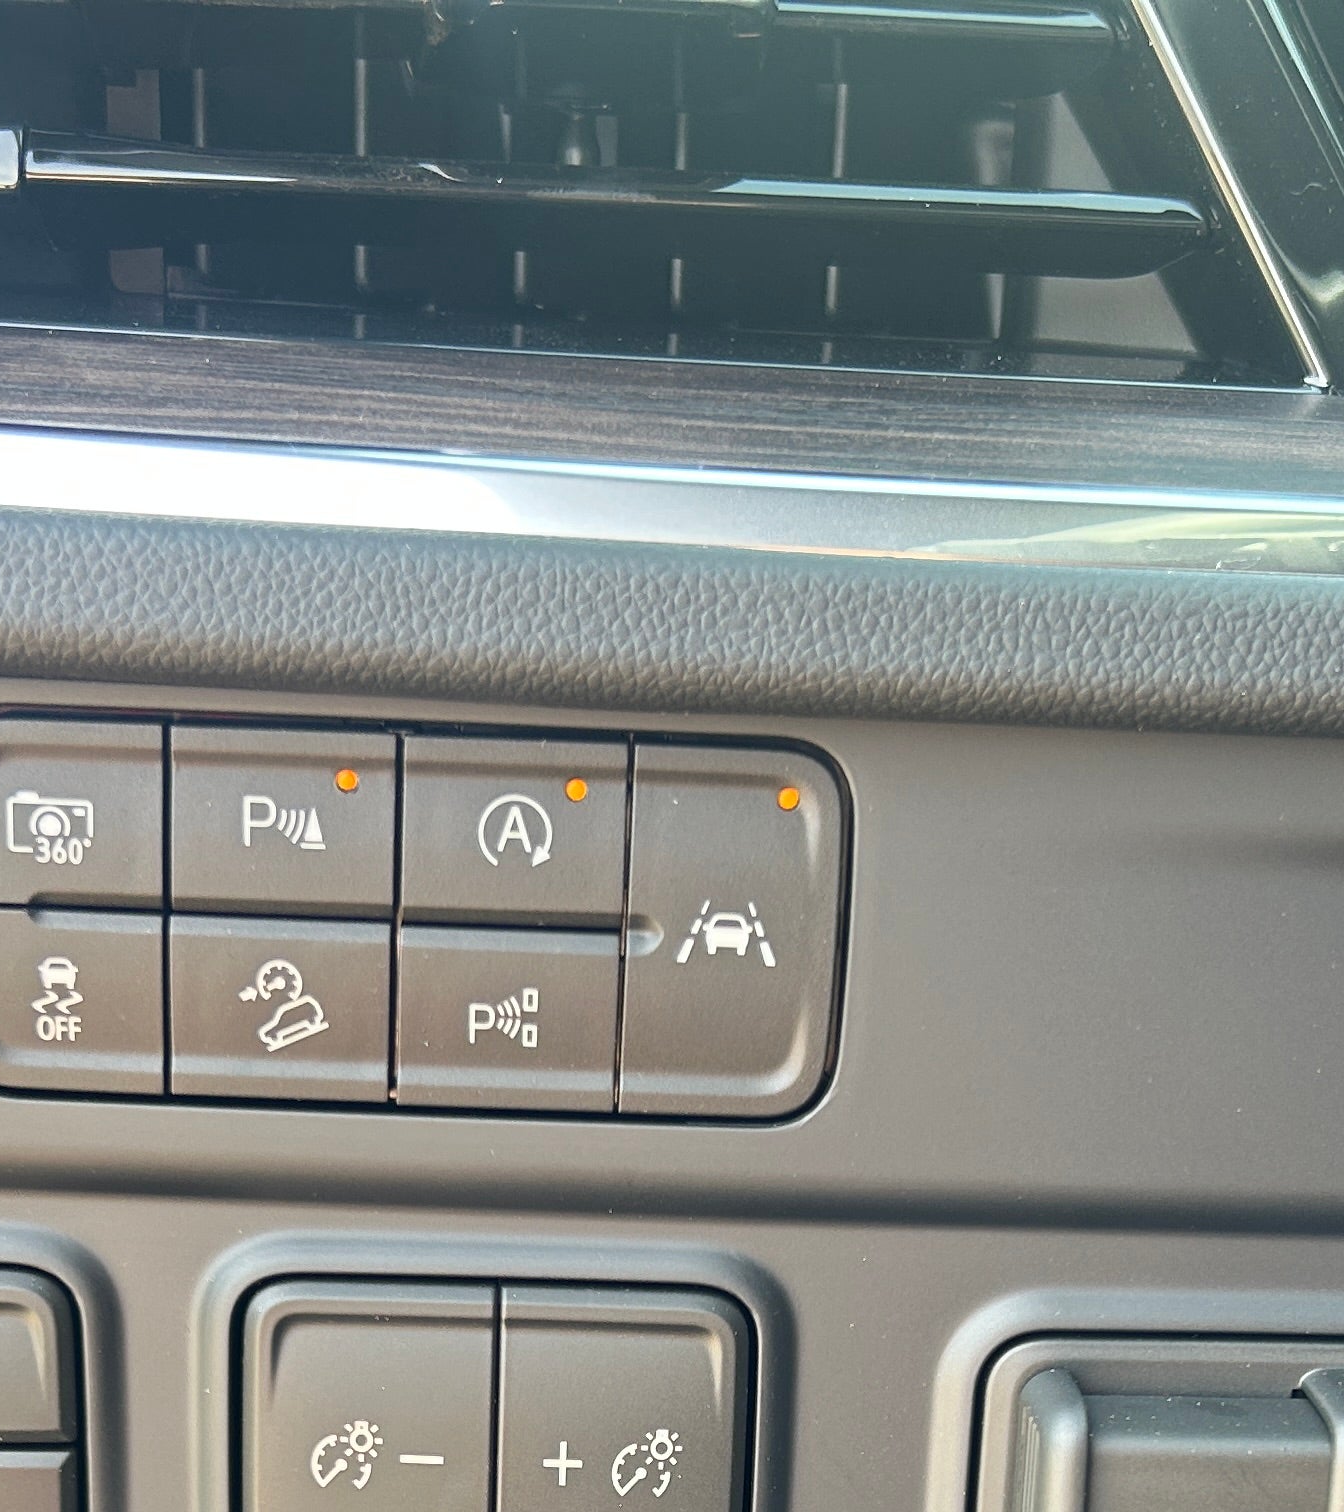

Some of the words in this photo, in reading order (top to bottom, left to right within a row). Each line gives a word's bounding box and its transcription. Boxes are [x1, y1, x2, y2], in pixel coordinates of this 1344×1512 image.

[242, 796, 277, 847] P
[497, 806, 532, 853] A
[36, 1014, 82, 1042] OFF
[468, 1003, 496, 1044] P
